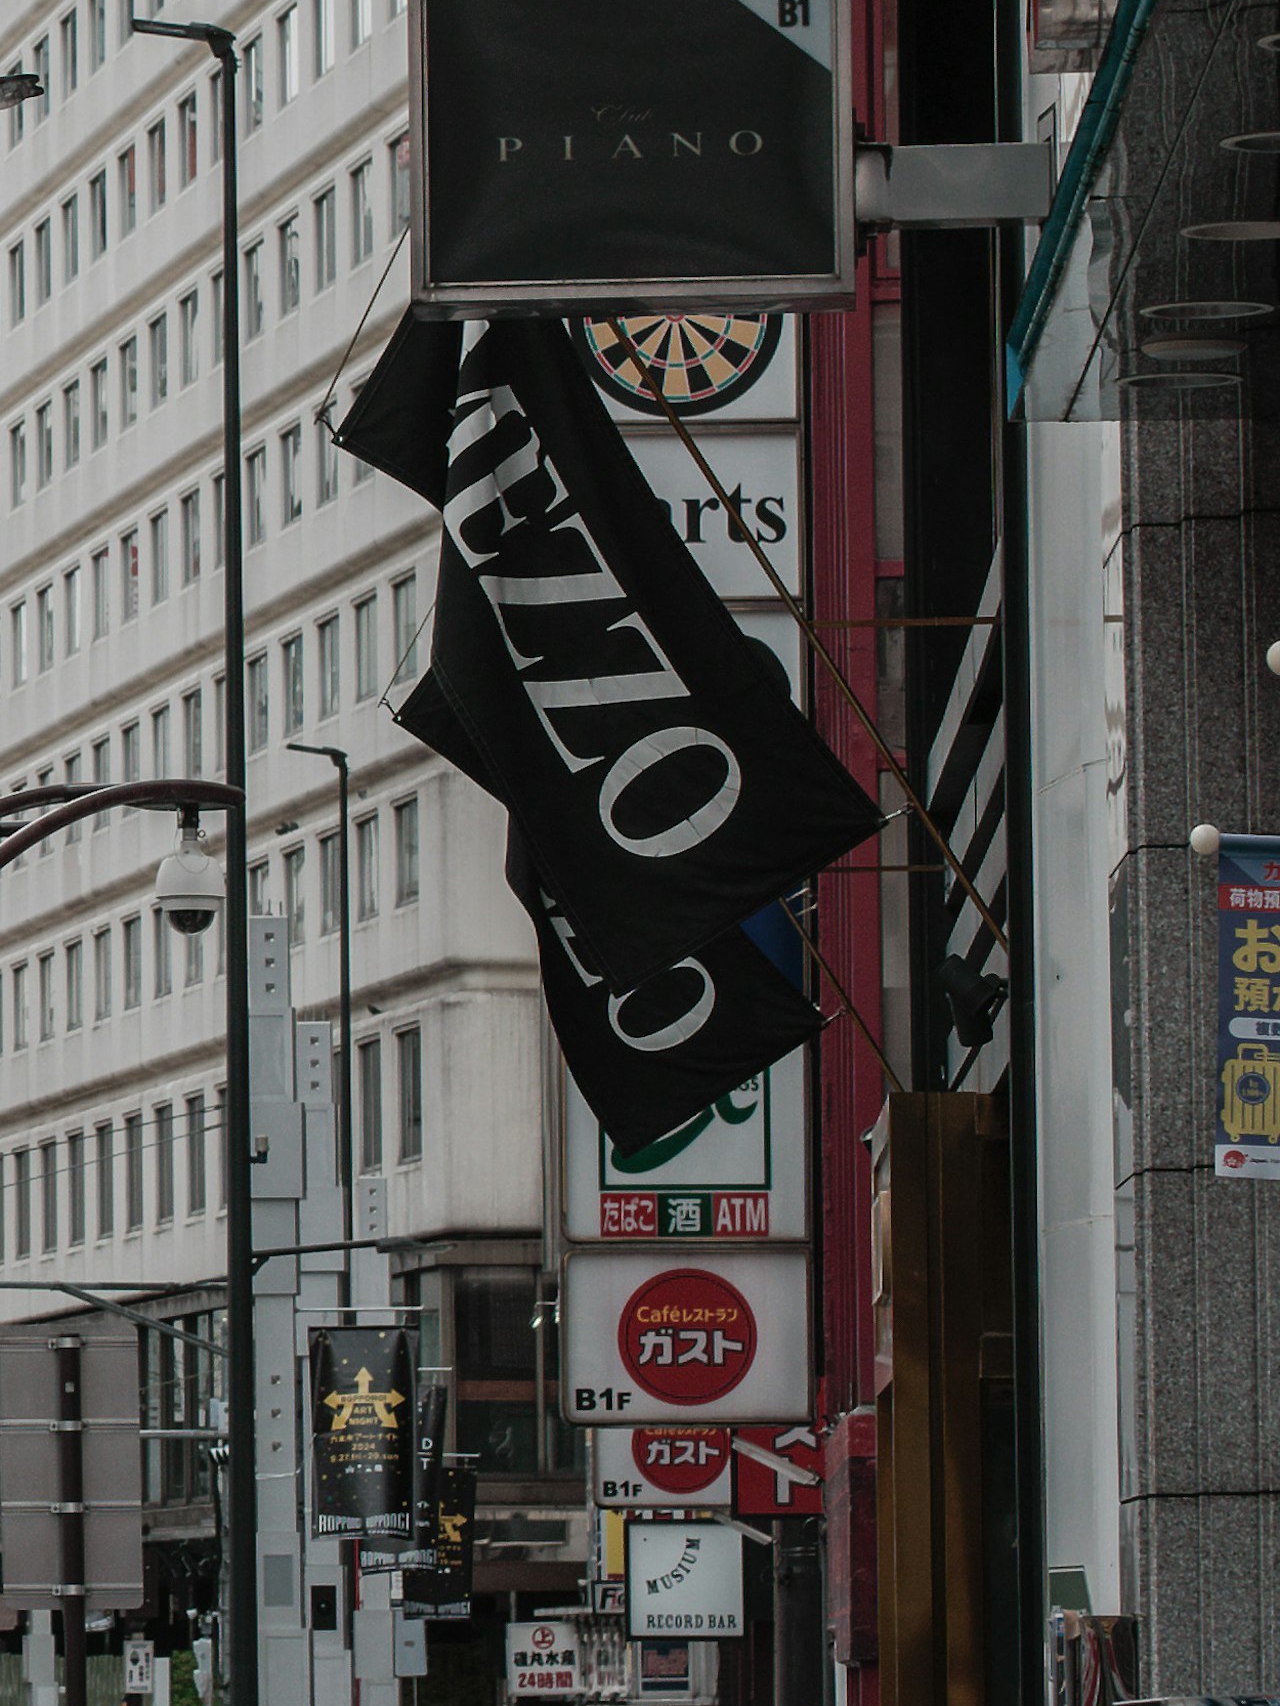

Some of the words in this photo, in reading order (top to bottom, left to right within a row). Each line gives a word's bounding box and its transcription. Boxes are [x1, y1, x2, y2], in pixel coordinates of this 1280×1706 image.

[498, 129, 764, 163] PIANO
[602, 1198, 654, 1233] たばこ
[667, 1198, 702, 1233] 酒
[716, 1198, 768, 1233] ATM
[639, 1329, 744, 1366] ガスト
[575, 1388, 632, 1411] B1F
[646, 1440, 720, 1465] ガスト
[603, 1481, 643, 1497] B1F
[646, 1614, 703, 1629] RECORD
[708, 1614, 737, 1629] BAR
[518, 1672, 573, 1688] 24時間
